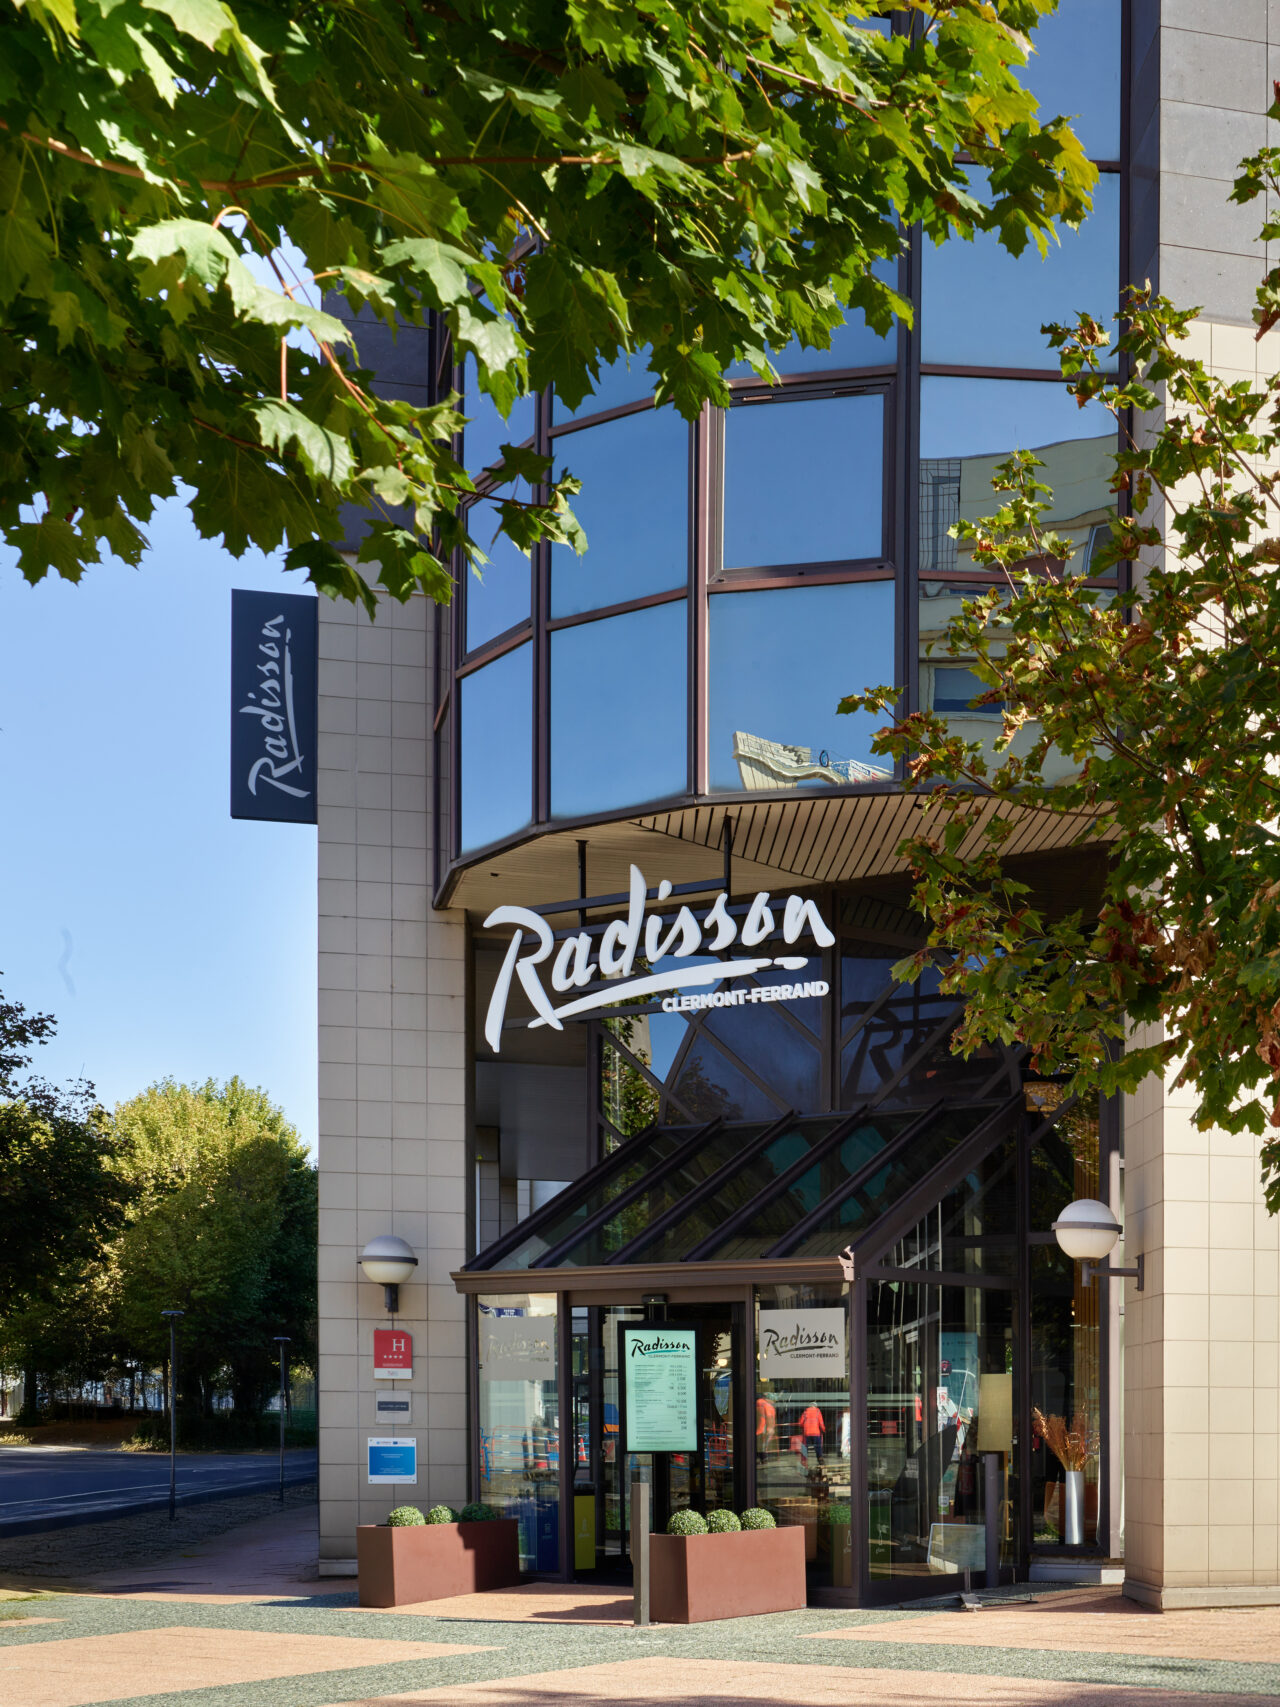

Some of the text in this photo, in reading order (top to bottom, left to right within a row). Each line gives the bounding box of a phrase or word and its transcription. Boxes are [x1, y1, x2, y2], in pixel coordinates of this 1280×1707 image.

[239, 614, 311, 798] Radisson
[483, 864, 836, 1053] Radisson
[662, 981, 830, 1013] CLERMONT-FERRAND
[392, 1338, 405, 1352] H
[631, 1336, 690, 1357] Radisson
[763, 1323, 839, 1360] Radisson
[790, 1352, 839, 1360] CLERMONT-FERRAND
